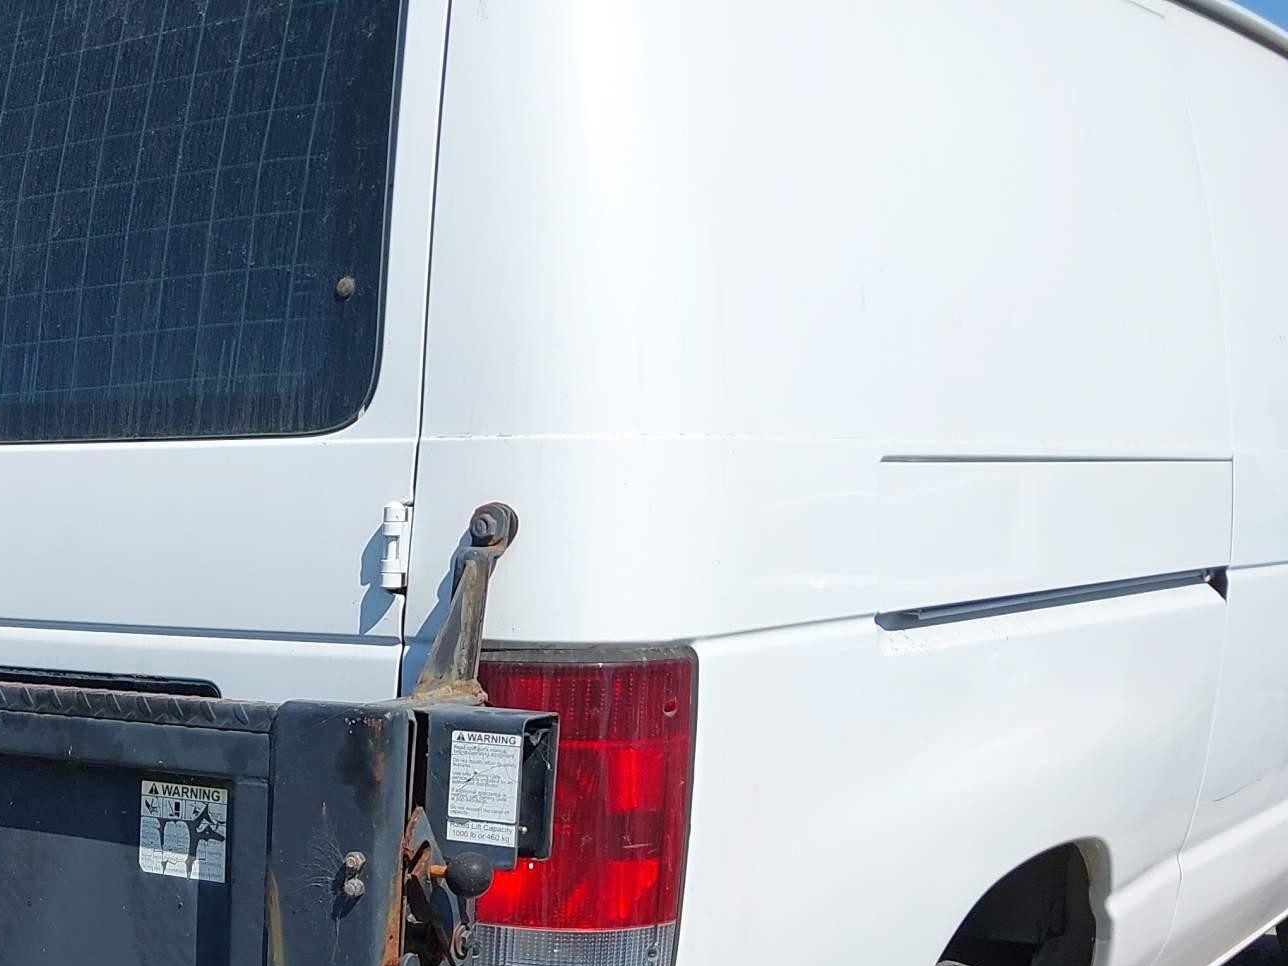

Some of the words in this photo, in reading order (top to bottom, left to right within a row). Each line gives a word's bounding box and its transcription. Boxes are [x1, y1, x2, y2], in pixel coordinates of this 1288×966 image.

[467, 733, 516, 745] WARNING
[161, 784, 220, 802] WARNING
[453, 829, 469, 837] 1000
[483, 824, 513, 835] Capacity
